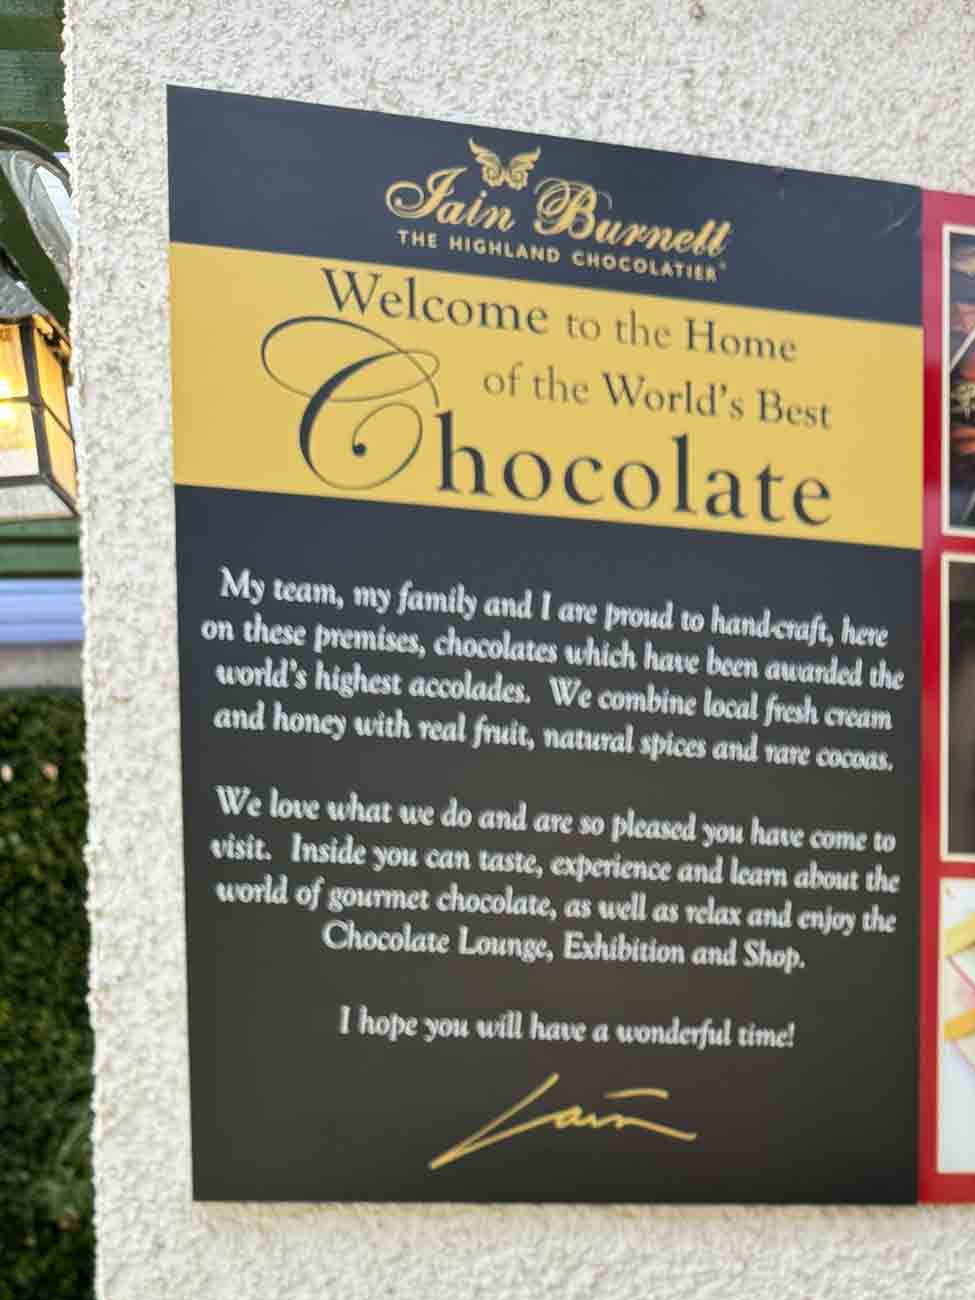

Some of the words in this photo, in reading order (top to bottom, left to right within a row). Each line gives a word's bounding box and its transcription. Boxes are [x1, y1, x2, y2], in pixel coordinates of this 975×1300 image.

[385, 167, 515, 232] Iain
[397, 229, 437, 249] THE
[449, 235, 561, 264] HIGHLAND
[321, 267, 549, 335] Welcome
[566, 313, 601, 341] to
[615, 309, 672, 349] the
[684, 316, 798, 362] Home
[260, 316, 833, 527] Chocolate
[482, 361, 524, 398] of
[533, 365, 590, 405] the
[602, 371, 744, 421] World's
[756, 388, 832, 430] Best
[220, 565, 266, 606] My
[272, 578, 345, 610] team,
[352, 586, 392, 615] my
[395, 580, 478, 622] family
[483, 588, 533, 620] and
[540, 590, 552, 621] I
[557, 602, 598, 625] are
[603, 600, 675, 633] proud
[680, 610, 705, 633] to
[710, 603, 835, 647] hand-craft,
[840, 614, 889, 649] here
[200, 619, 236, 642] on
[242, 611, 307, 647] these
[312, 623, 427, 659] premises,
[432, 625, 559, 665] chocolates
[563, 635, 638, 671] which
[642, 640, 700, 675] have
[706, 644, 759, 679] been
[764, 655, 864, 687] awarded
[869, 658, 905, 691] the
[215, 655, 308, 690] world's
[314, 659, 403, 699] highest
[407, 668, 532, 705] accolades.
[548, 675, 593, 709] We
[597, 682, 697, 717] combine
[703, 686, 759, 721] local
[762, 693, 820, 728] fresh
[823, 707, 893, 731] cream
[213, 699, 267, 731] and
[272, 700, 347, 742] honey
[353, 708, 413, 740] with
[417, 711, 467, 743] real
[471, 713, 535, 752] fruit,
[543, 723, 635, 754] natural
[639, 730, 707, 762] spices
[711, 731, 760, 763] and
[763, 743, 811, 767] rare
[815, 747, 894, 772] cocoas.
[215, 784, 263, 818] We
[269, 786, 321, 821] love
[325, 791, 393, 824] what
[397, 804, 435, 827] we
[439, 797, 473, 829] do
[477, 800, 528, 832] and
[532, 812, 574, 835] are
[577, 815, 606, 836] so
[610, 807, 697, 844] pleased
[701, 822, 745, 849] you
[749, 815, 805, 849] have
[808, 829, 868, 852] come
[873, 831, 897, 853] to
[209, 832, 273, 861] visit.
[290, 831, 367, 865] Inside
[371, 845, 419, 872] you
[423, 848, 472, 871] can
[477, 849, 544, 880] taste,
[549, 852, 673, 883] experience
[676, 854, 725, 885] and
[729, 855, 789, 888] learn
[793, 860, 860, 892] about
[865, 863, 901, 894] the
[215, 873, 289, 905] world
[293, 875, 326, 912] of
[325, 886, 430, 913] gourmet
[434, 882, 558, 921] chocolate,
[563, 898, 592, 919] as
[597, 891, 647, 921] well
[651, 903, 679, 924] as
[684, 895, 743, 927] relax
[746, 899, 793, 929] and
[796, 906, 857, 937] enjoy
[861, 903, 897, 934] the
[321, 919, 451, 954] Chocolate
[457, 924, 554, 963] Lounge,
[562, 929, 686, 964] Exhibition
[690, 937, 738, 967] and
[742, 938, 806, 975] Shop.
[339, 1005, 351, 1035] I
[357, 1004, 419, 1043] hope
[423, 1017, 470, 1043] you
[475, 1009, 523, 1040] will
[528, 1011, 587, 1043] have
[591, 1023, 610, 1043] a
[615, 1015, 733, 1051] wonderful
[737, 1021, 796, 1049] time!
